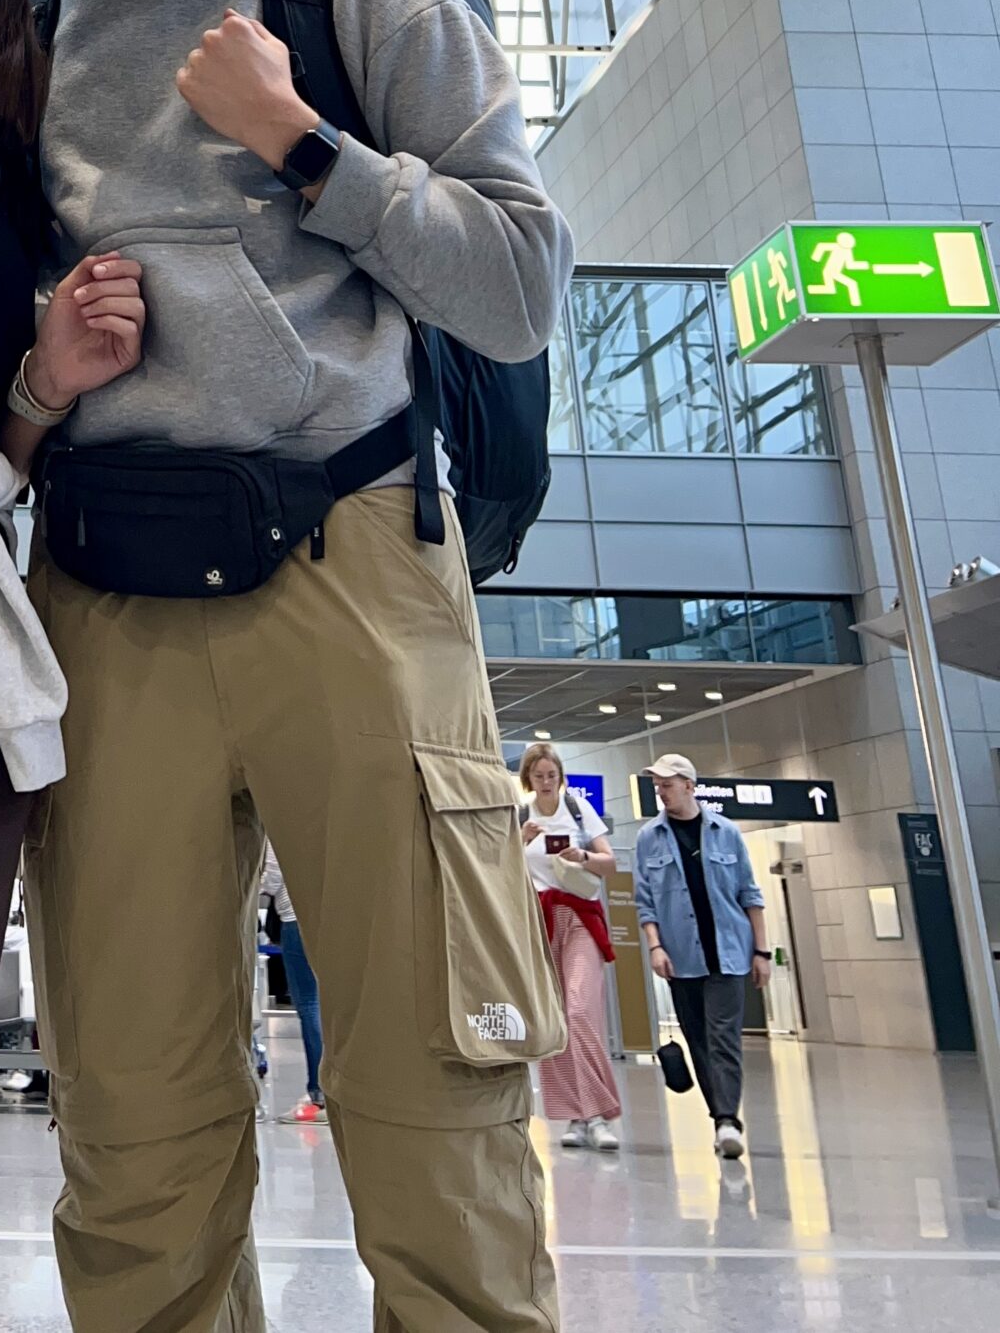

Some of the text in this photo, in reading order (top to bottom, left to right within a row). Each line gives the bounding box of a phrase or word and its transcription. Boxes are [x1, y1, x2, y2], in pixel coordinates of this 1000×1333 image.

[482, 1002, 505, 1015] THE
[466, 1014, 505, 1027] NORTH
[478, 1027, 505, 1040] FACE
